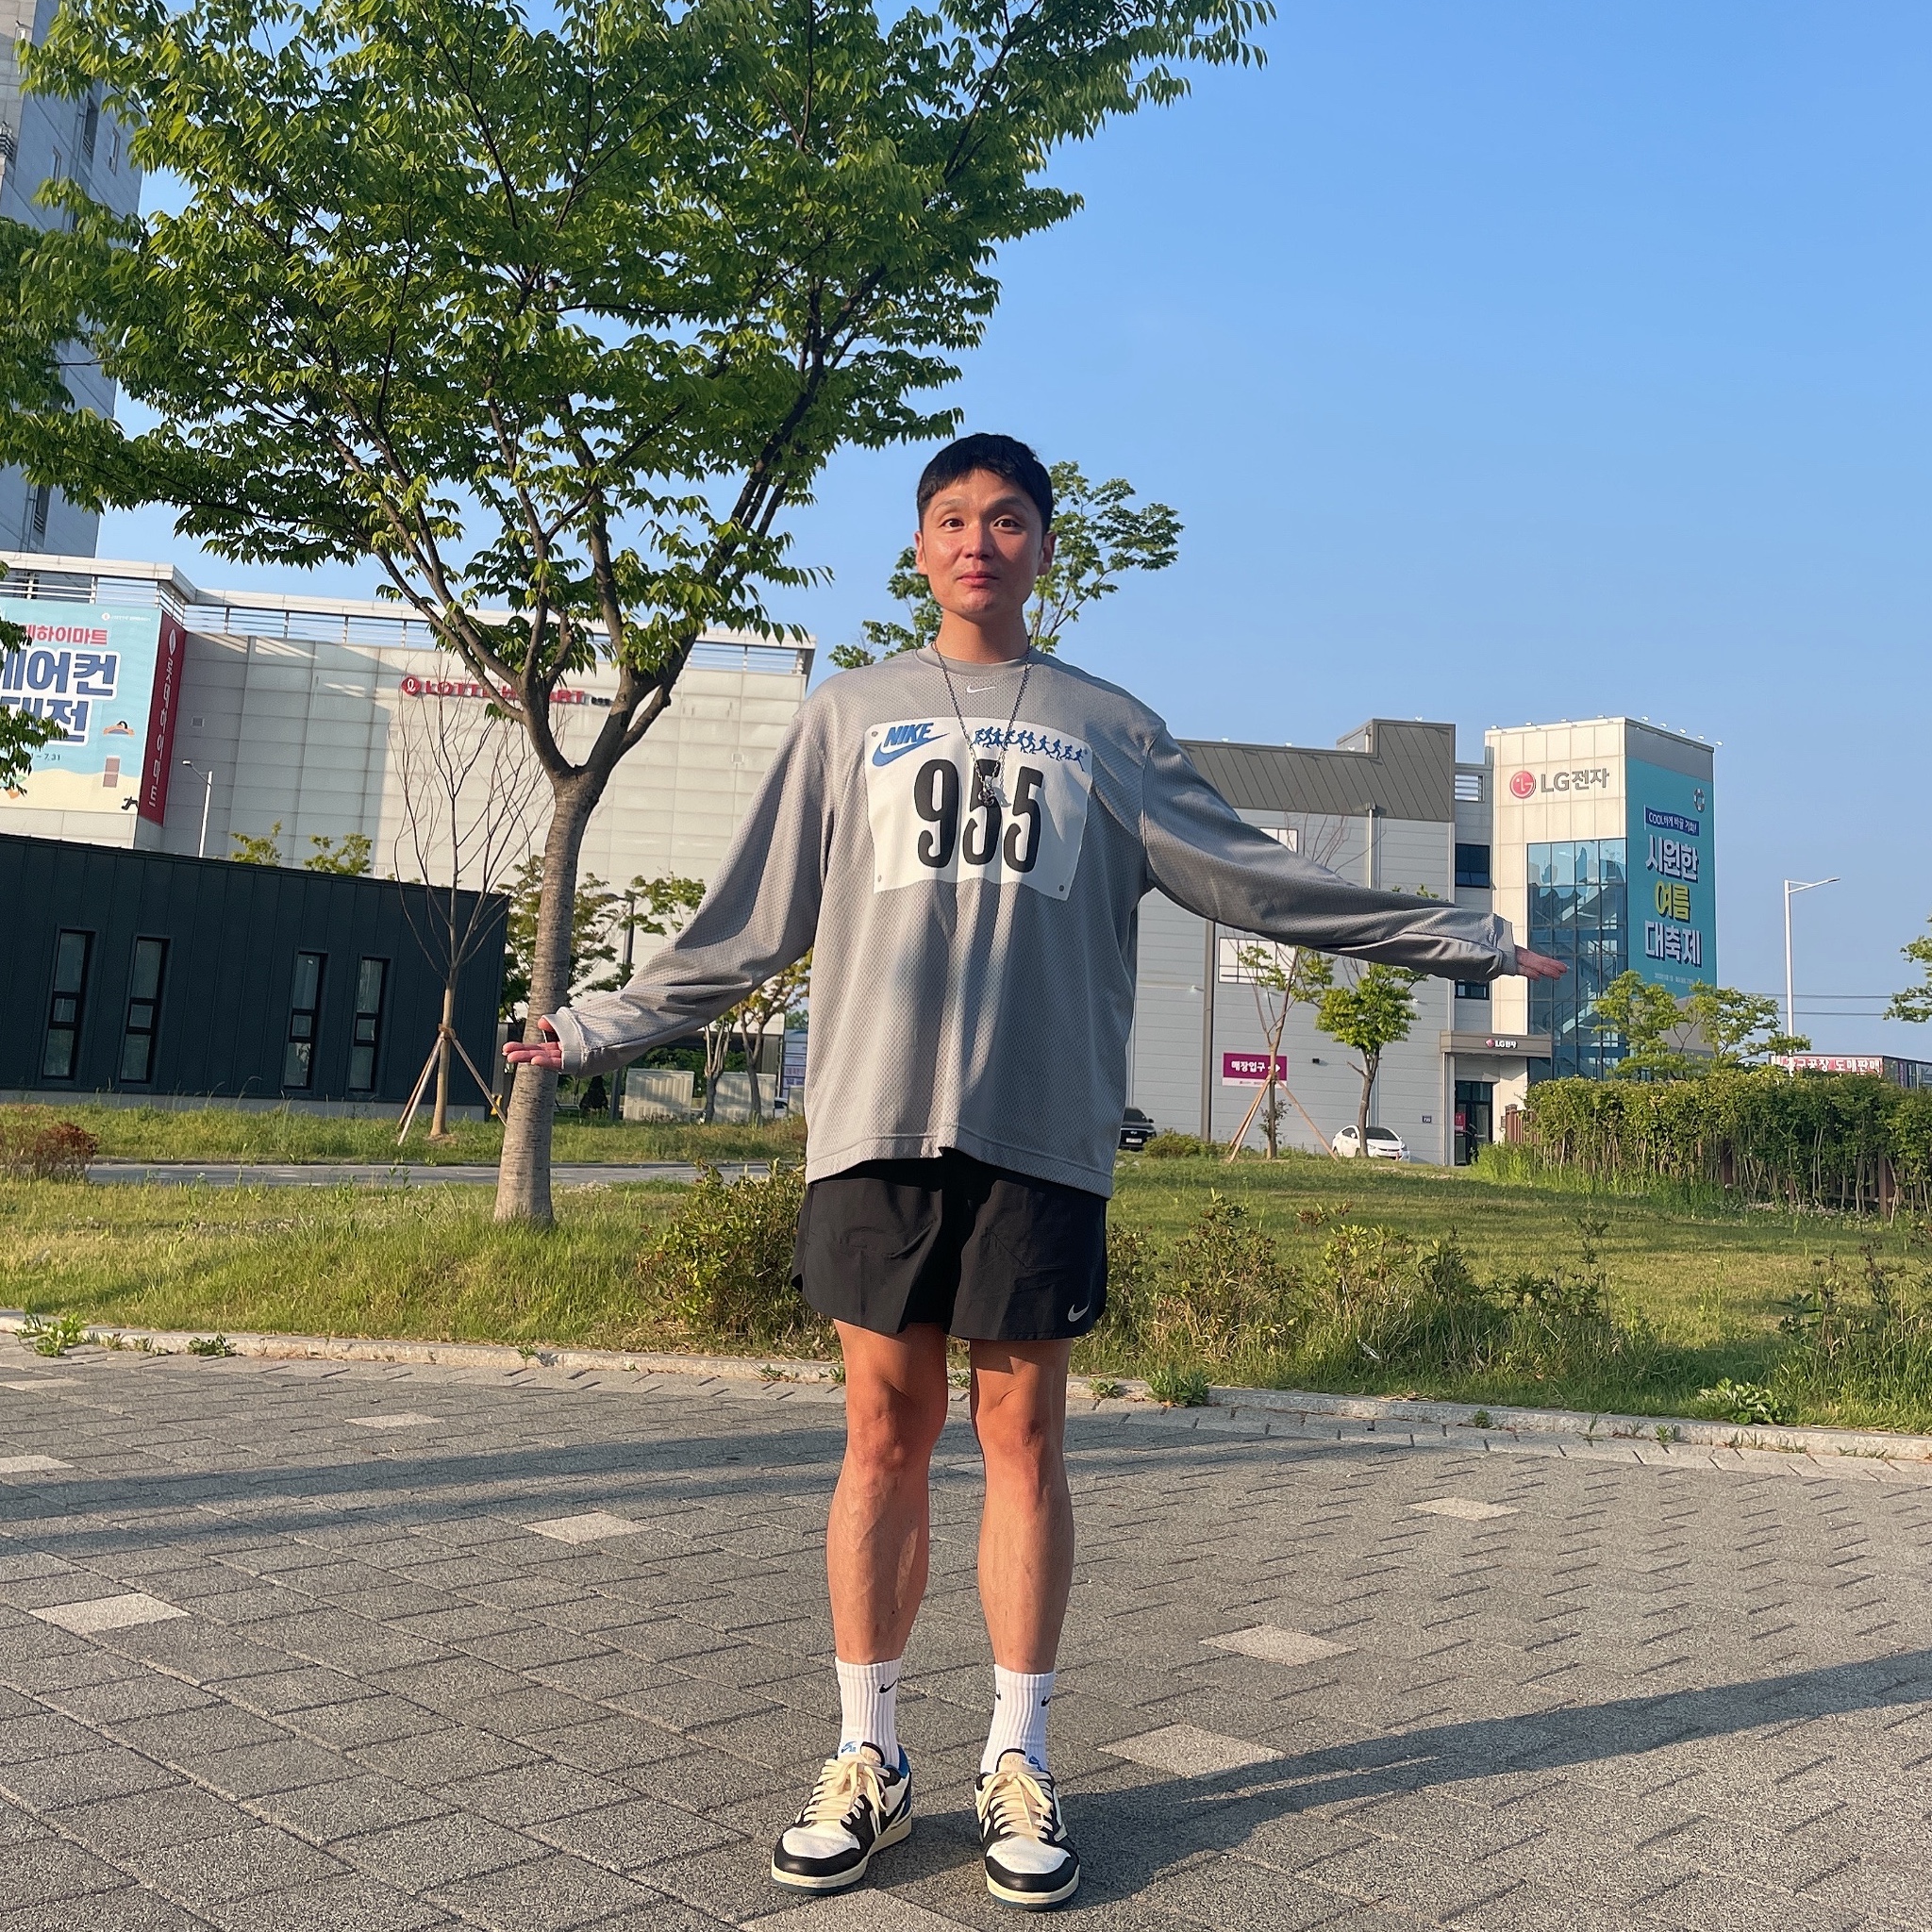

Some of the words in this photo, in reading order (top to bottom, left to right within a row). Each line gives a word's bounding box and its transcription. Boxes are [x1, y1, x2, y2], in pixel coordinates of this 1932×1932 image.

[883, 722, 934, 748] NIKE
[1541, 768, 1610, 793] LG전자
[913, 758, 1044, 874] 955
[1645, 834, 1699, 883] 시원한
[1654, 879, 1690, 924] 여름
[1644, 920, 1703, 967] 대축제
[1231, 1060, 1266, 1074] 매장입구
